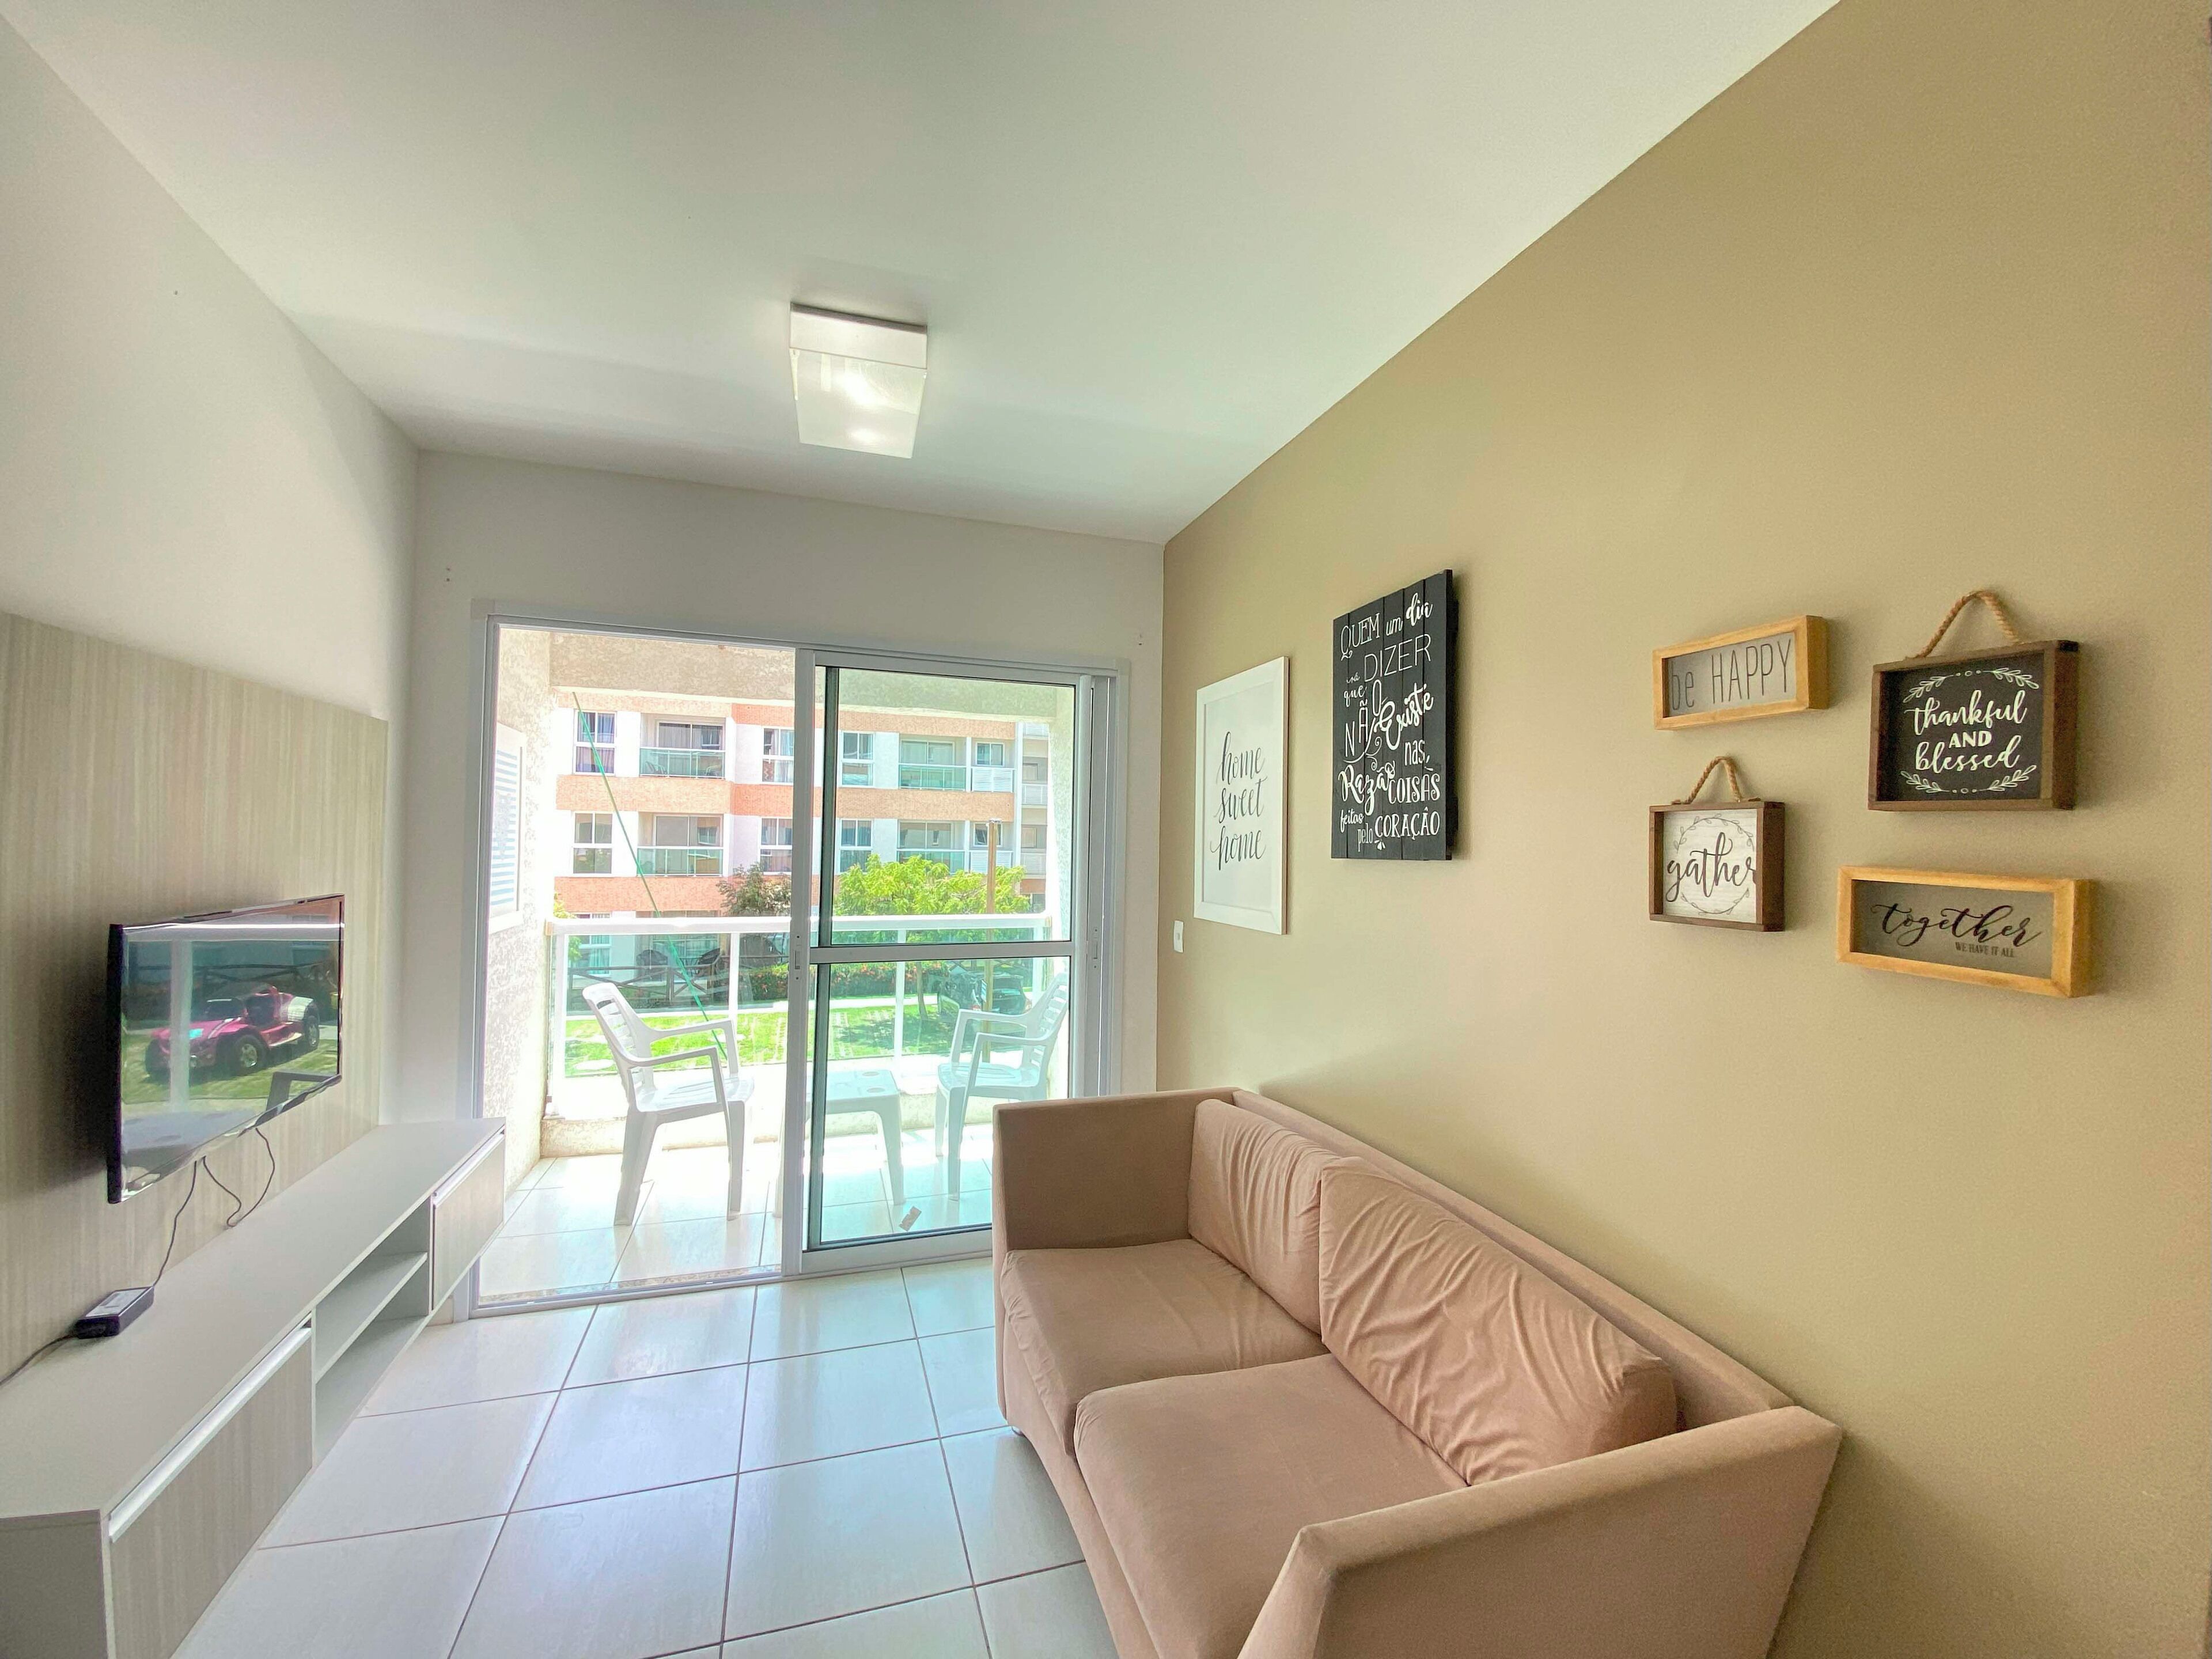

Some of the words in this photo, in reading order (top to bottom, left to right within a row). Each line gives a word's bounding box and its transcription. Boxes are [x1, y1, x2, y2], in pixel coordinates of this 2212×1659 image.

[1340, 613, 1380, 661] QUEM
[1386, 617, 1403, 636] um
[1364, 634, 1431, 682] DIZER
[1343, 685, 1365, 707] que
[1672, 662, 1695, 710] be
[1711, 639, 1791, 704] HAPPY
[1904, 690, 2028, 736] thankful
[1217, 731, 1266, 785] home
[1404, 739, 1426, 766] nas
[1915, 735, 2022, 774] blessed
[1949, 730, 1992, 749] AND
[1213, 776, 1267, 824] sweet
[1388, 773, 1440, 804] COISAS
[1340, 809, 1364, 833] feitas
[1357, 823, 1373, 853] pelo
[1210, 825, 1266, 871] home
[1665, 832, 1756, 903] gather
[1870, 903, 2042, 948] together
[1955, 941, 1967, 952] WE
